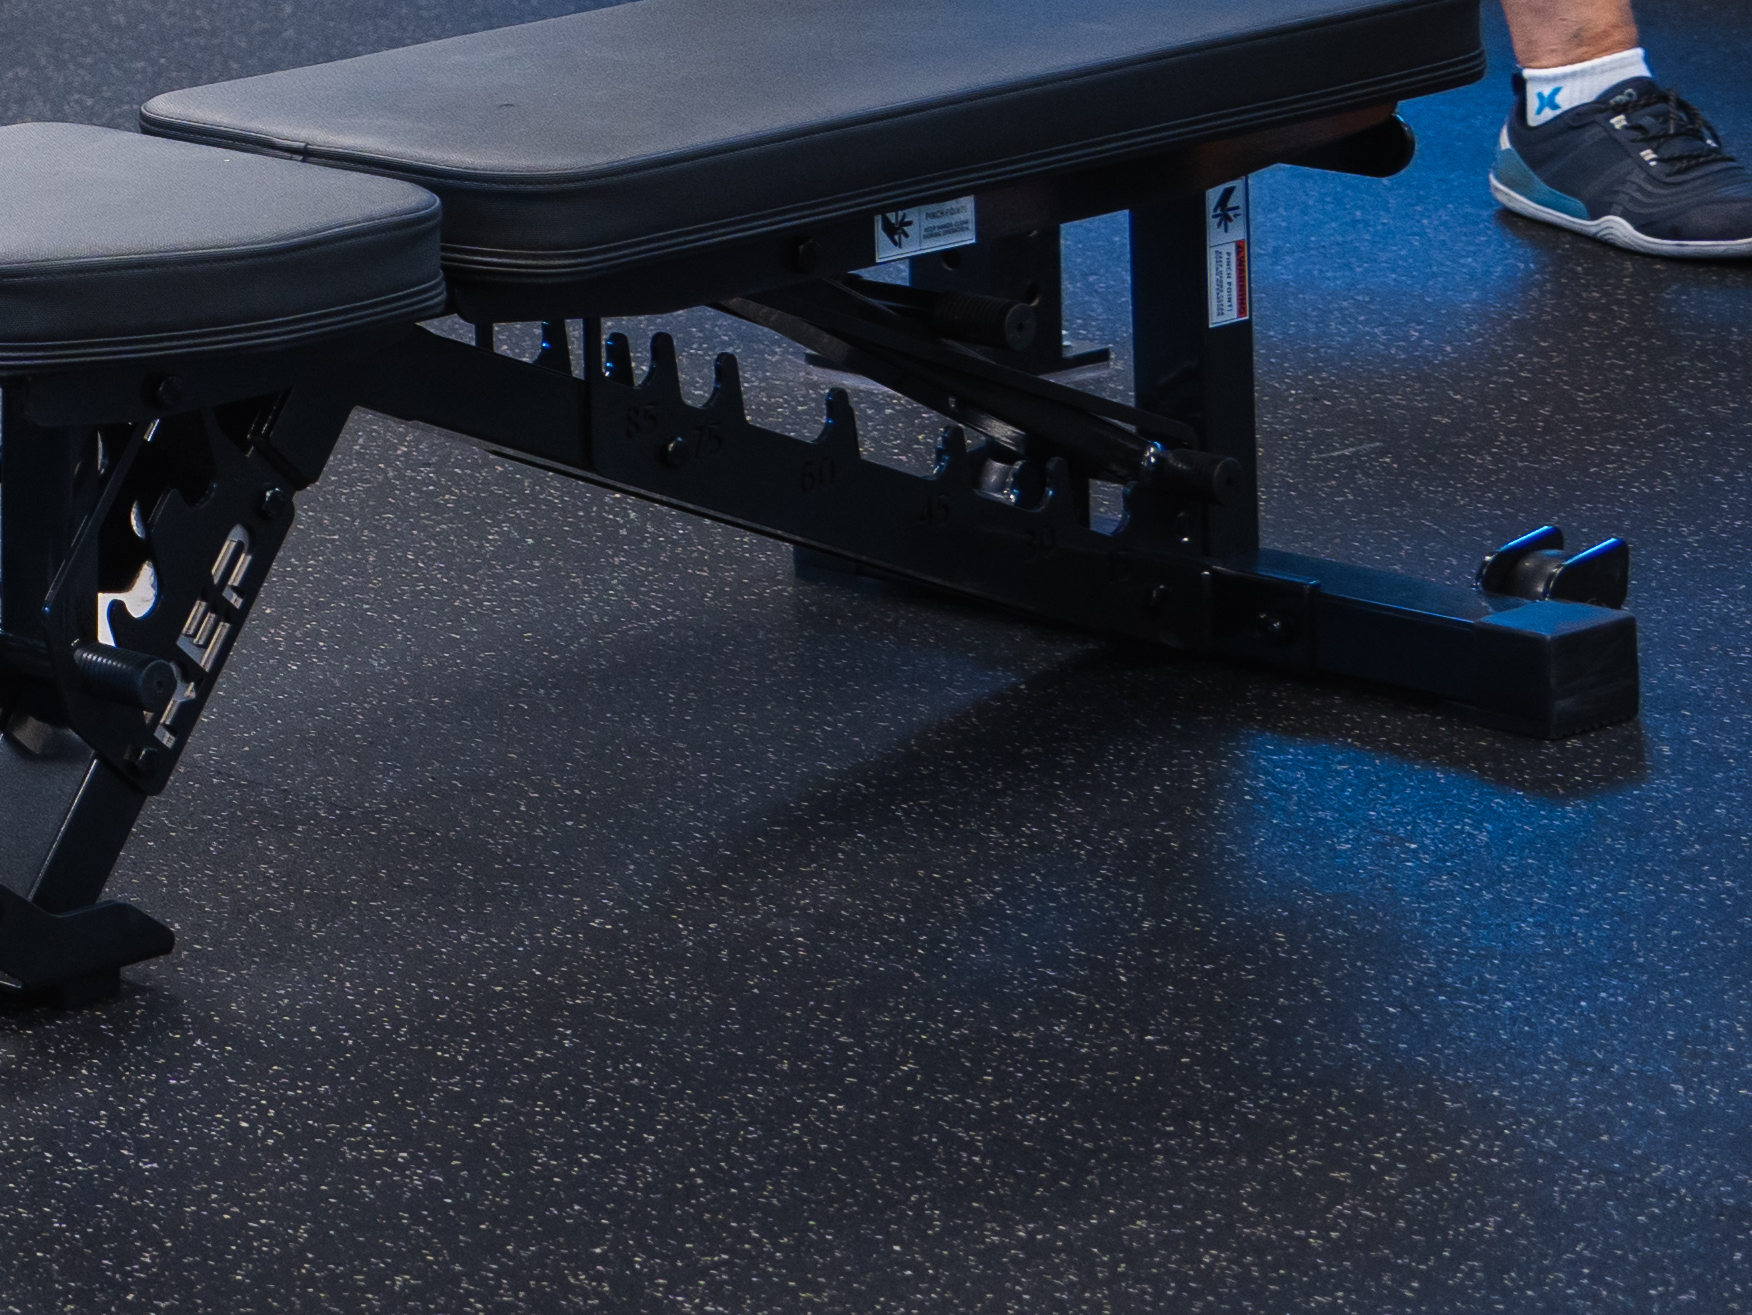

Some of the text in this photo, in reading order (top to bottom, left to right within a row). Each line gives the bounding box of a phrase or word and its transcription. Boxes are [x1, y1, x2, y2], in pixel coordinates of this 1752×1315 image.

[625, 405, 658, 439] 85
[694, 423, 724, 455] 75
[800, 458, 836, 493] 60
